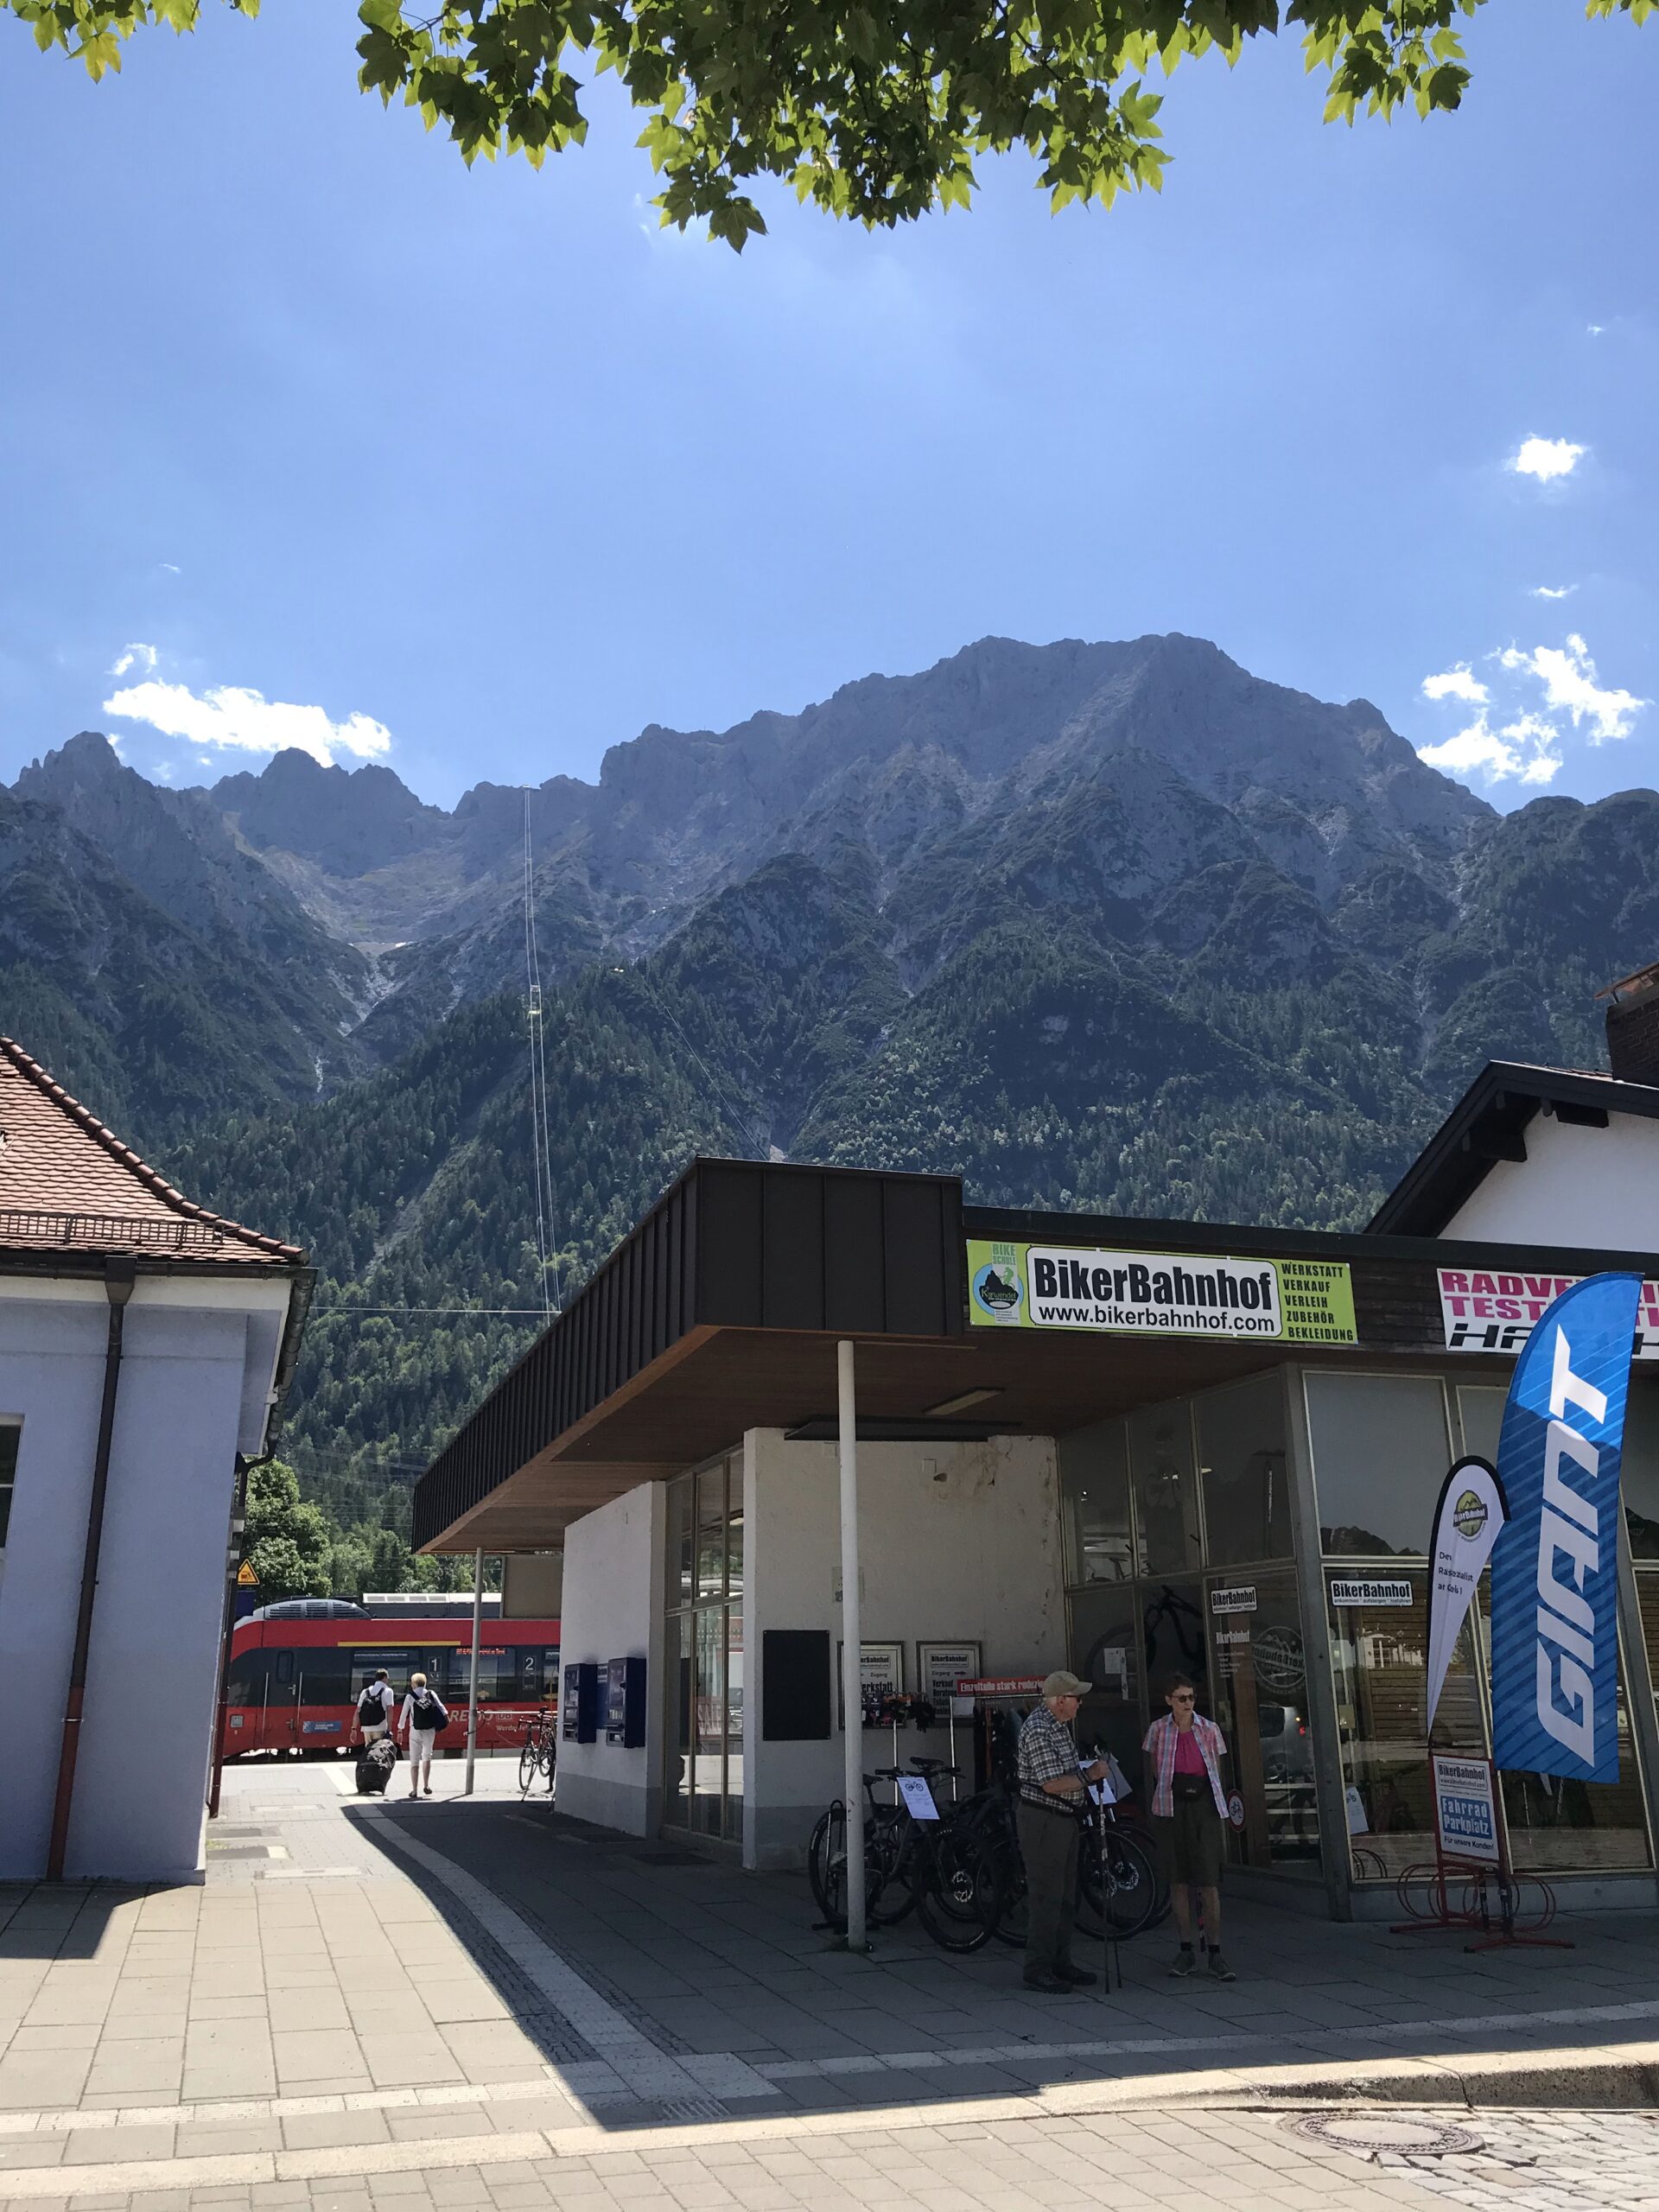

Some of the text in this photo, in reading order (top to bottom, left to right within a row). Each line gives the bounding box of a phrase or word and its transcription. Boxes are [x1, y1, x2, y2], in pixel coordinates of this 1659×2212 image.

[992, 1244, 1015, 1255] BIKE
[993, 1255, 1017, 1266] SCHULE
[1281, 1263, 1344, 1277] WERKSTATT
[1034, 1258, 1273, 1310] BikerBahnhof
[1283, 1279, 1331, 1292] VERKAUF
[981, 1287, 1016, 1299] Karwendel
[1285, 1294, 1328, 1308] VERLEIH
[1039, 1305, 1274, 1332] www.bikerbahnhof.com
[1287, 1310, 1334, 1324] ZUBEHÖR
[1288, 1326, 1354, 1341] BEKLEIDUNG
[1537, 1324, 1608, 1768] GIANT
[1332, 1584, 1410, 1597] BikerBahnhof
[1212, 1590, 1255, 1606] BikerBahnhof
[431, 1658, 437, 1671] 1
[525, 1657, 534, 1670] 2
[861, 1681, 893, 1693] erkstatt
[996, 1681, 1017, 1690] stark
[449, 1710, 493, 1722] REIO
[1439, 1764, 1485, 1780] BikerBahnhof
[1441, 1797, 1487, 1817] Fahrrad
[1444, 1815, 1490, 1835] Parkplatz
[1453, 1838, 1471, 1847] unsere
